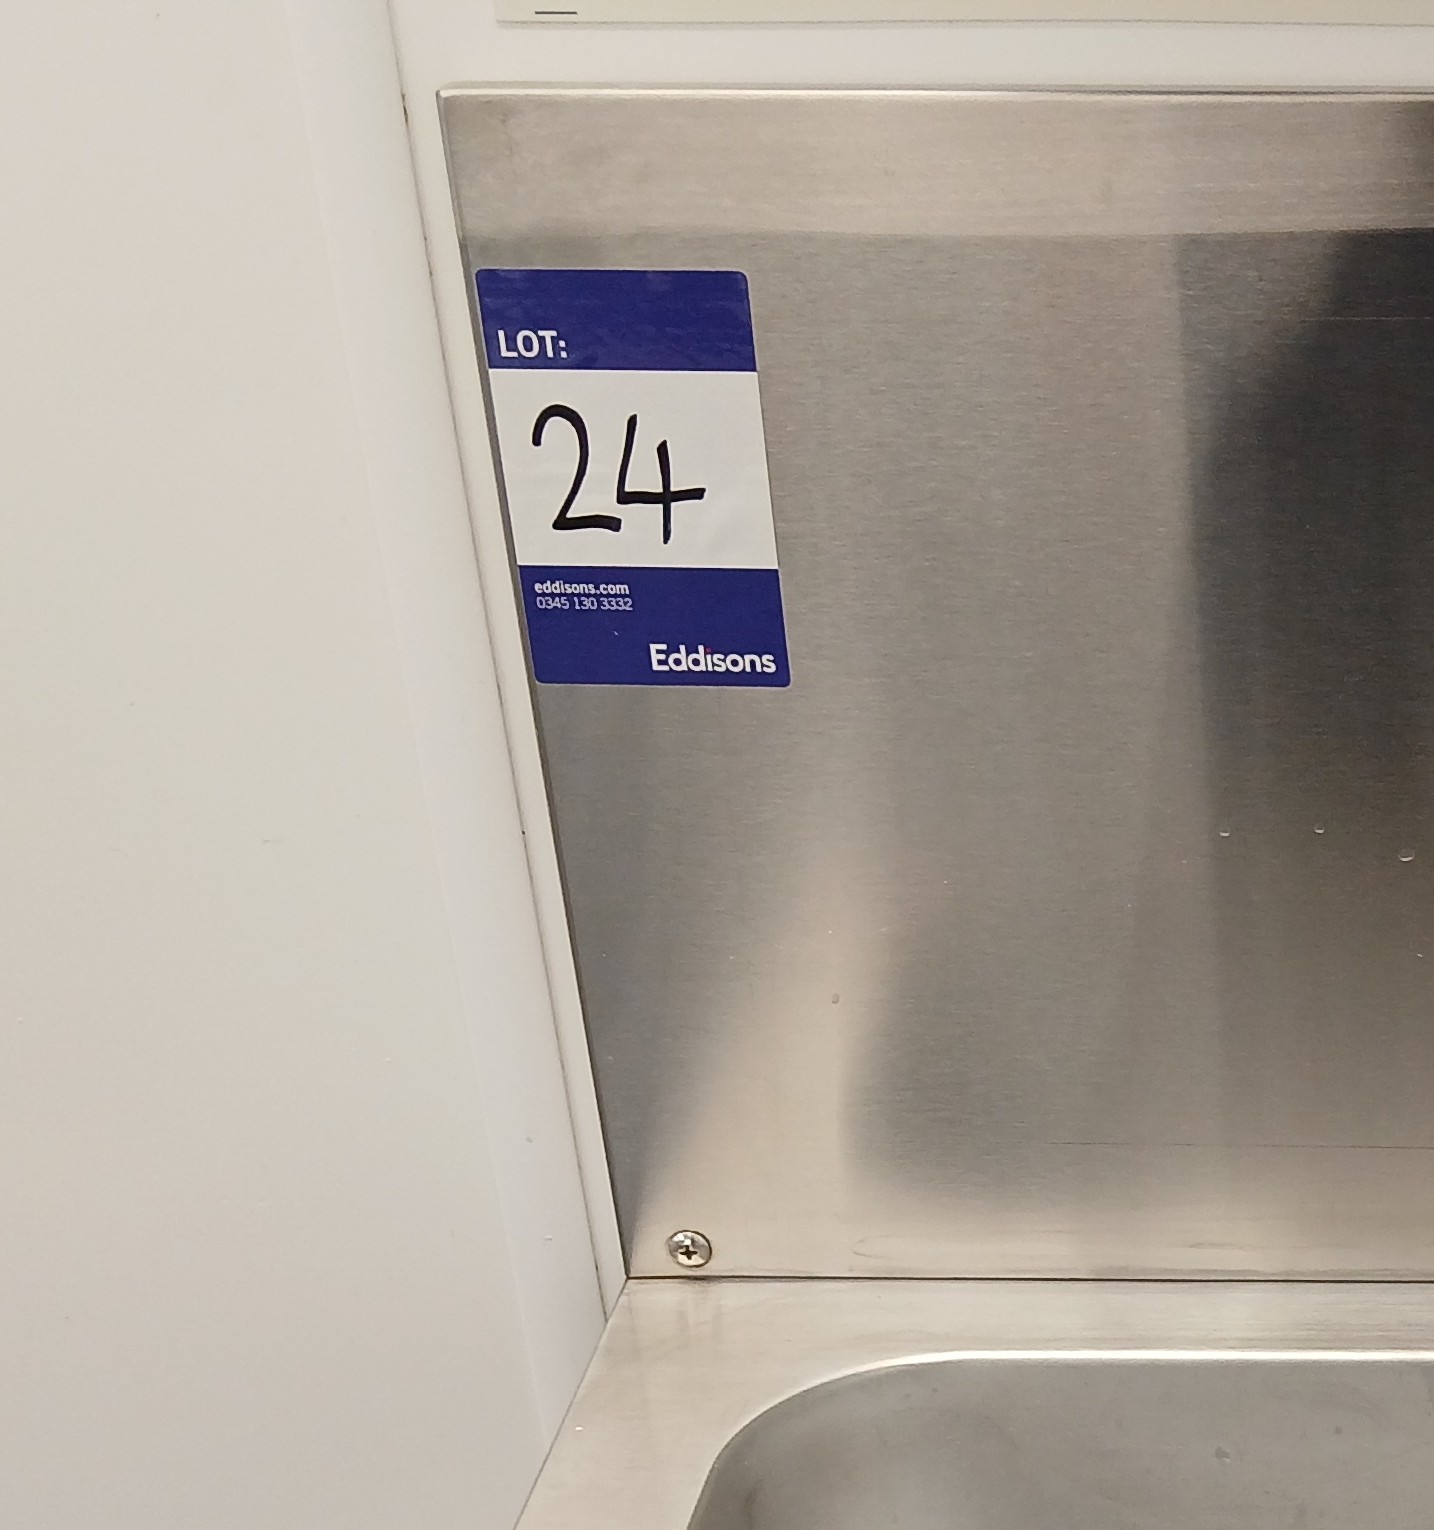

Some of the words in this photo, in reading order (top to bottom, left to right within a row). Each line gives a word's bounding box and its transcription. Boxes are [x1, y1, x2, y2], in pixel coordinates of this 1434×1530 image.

[497, 328, 569, 359] LOT:
[531, 403, 707, 545] 24
[534, 580, 630, 595] eddisons.com
[536, 596, 570, 611] 0345
[573, 596, 598, 611] 130
[600, 597, 634, 611] 3332
[649, 643, 777, 673] Eddisons
